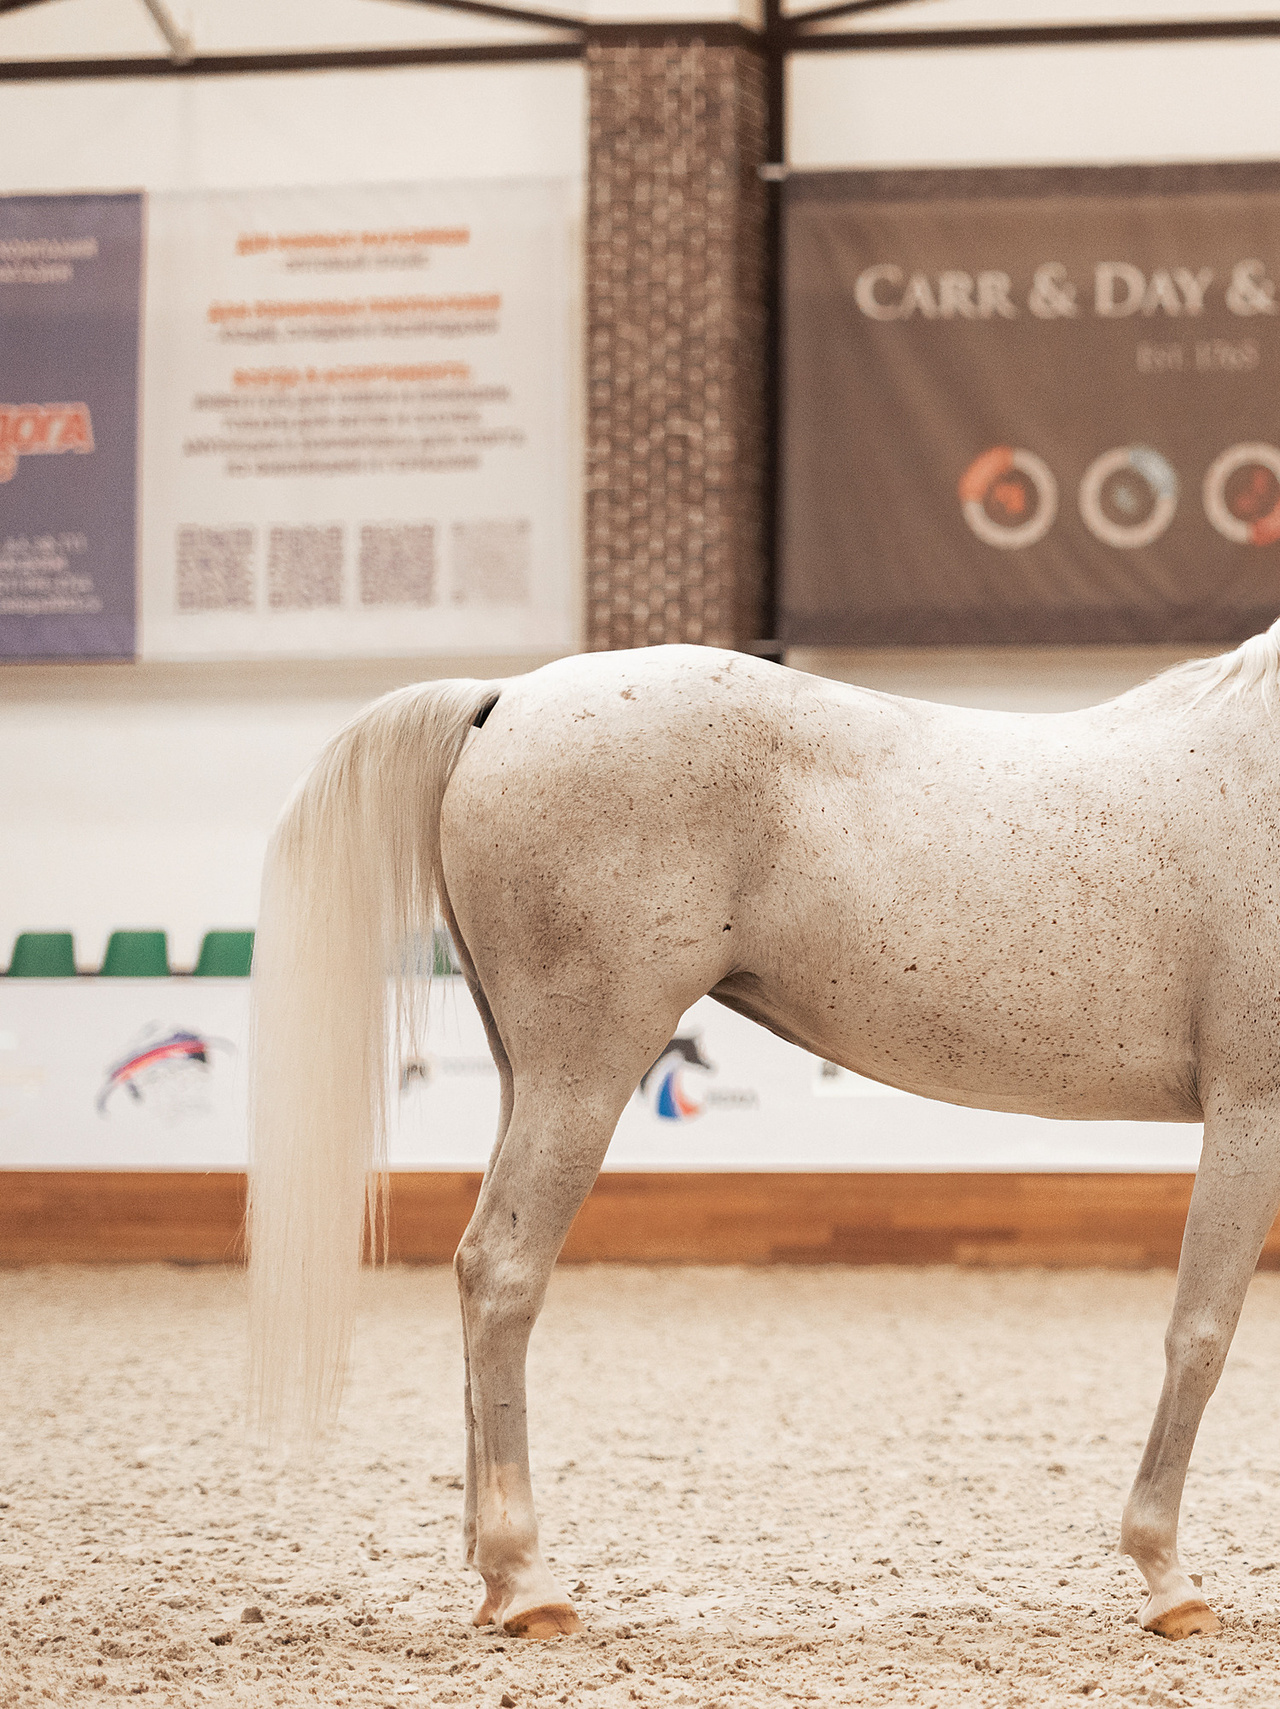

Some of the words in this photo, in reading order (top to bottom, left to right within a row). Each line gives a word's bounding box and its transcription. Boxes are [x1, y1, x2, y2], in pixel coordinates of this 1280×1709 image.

[854, 263, 1018, 320] CARR
[1028, 261, 1079, 319] &
[1095, 260, 1212, 318] DAY
[1225, 257, 1277, 316] &
